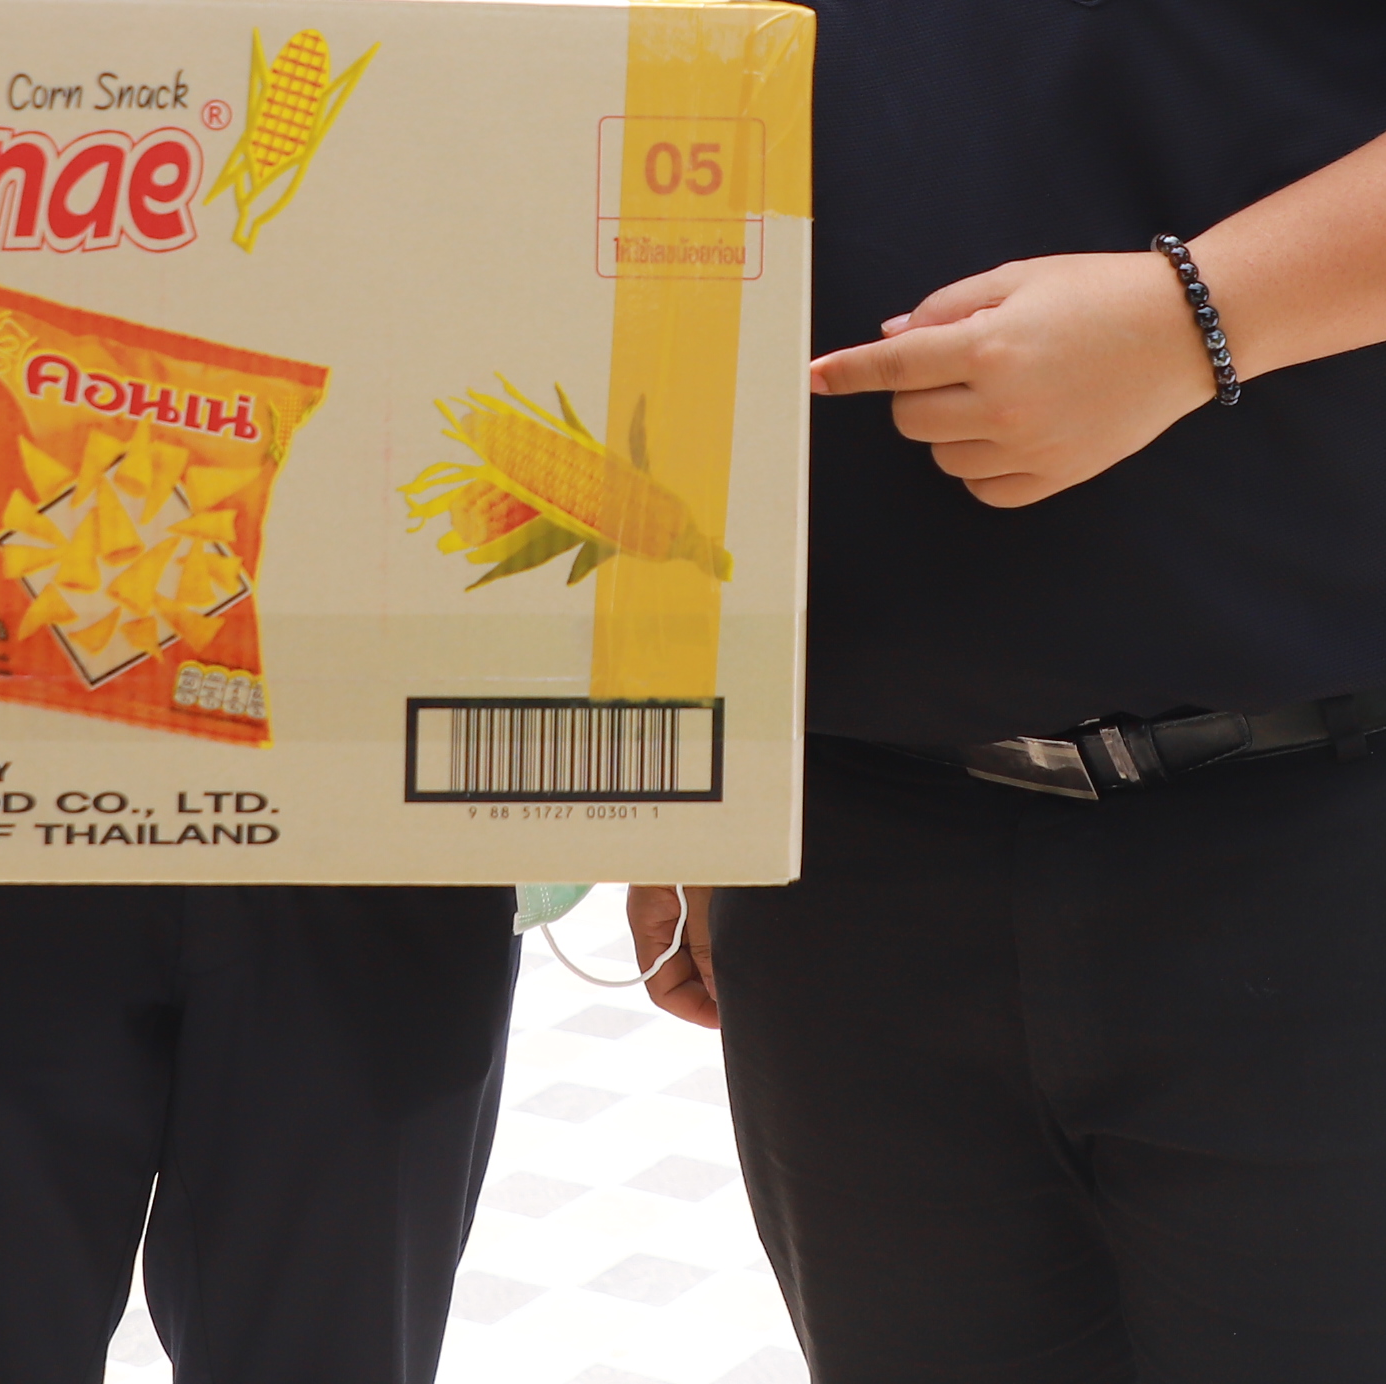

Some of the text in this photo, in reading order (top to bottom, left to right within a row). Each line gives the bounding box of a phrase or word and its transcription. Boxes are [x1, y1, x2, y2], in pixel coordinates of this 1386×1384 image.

[8, 73, 83, 112] Corn
[94, 69, 189, 113] Snack
[644, 141, 724, 196] 05
[25, 354, 261, 443] คอนเน่
[57, 791, 156, 820] CO.,
[178, 791, 281, 815] LTD.
[490, 806, 511, 819] 88
[36, 822, 281, 846] THAILAND
